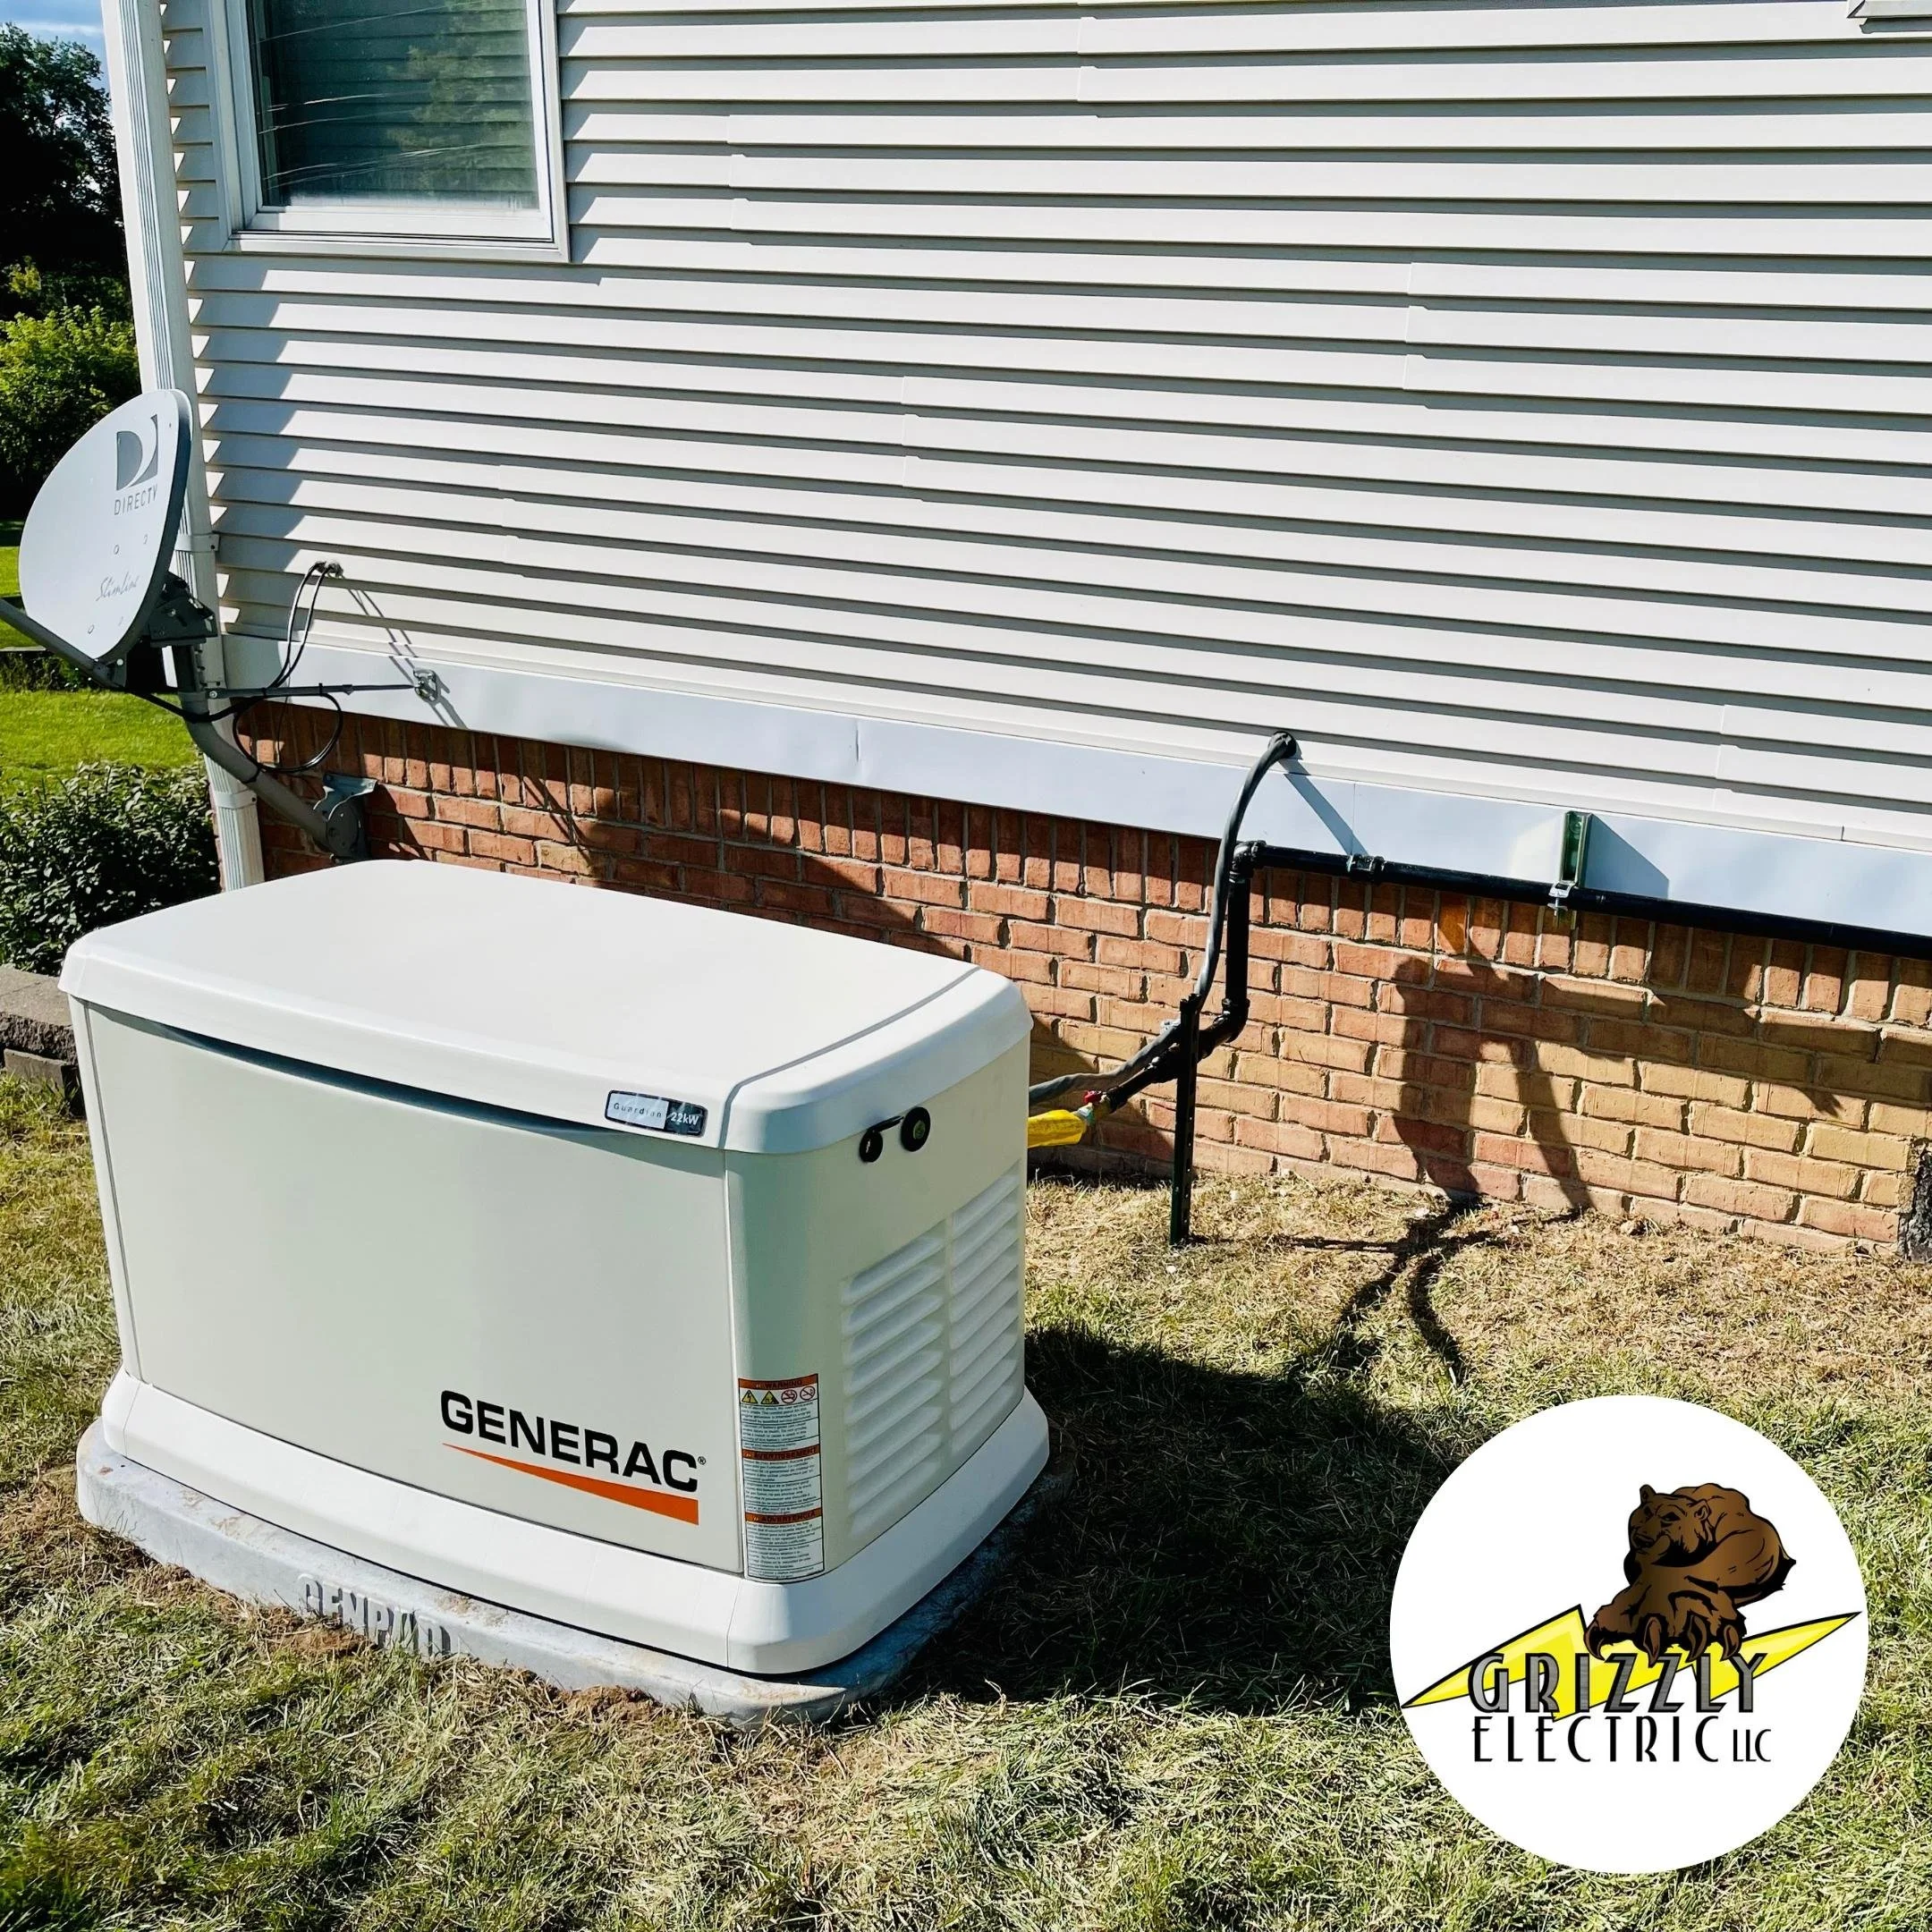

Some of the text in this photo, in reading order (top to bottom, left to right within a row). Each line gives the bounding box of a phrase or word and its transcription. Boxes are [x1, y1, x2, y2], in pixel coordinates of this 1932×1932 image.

[114, 483, 157, 515] DIRECTV
[613, 1102, 699, 1125] Guardian 22kW
